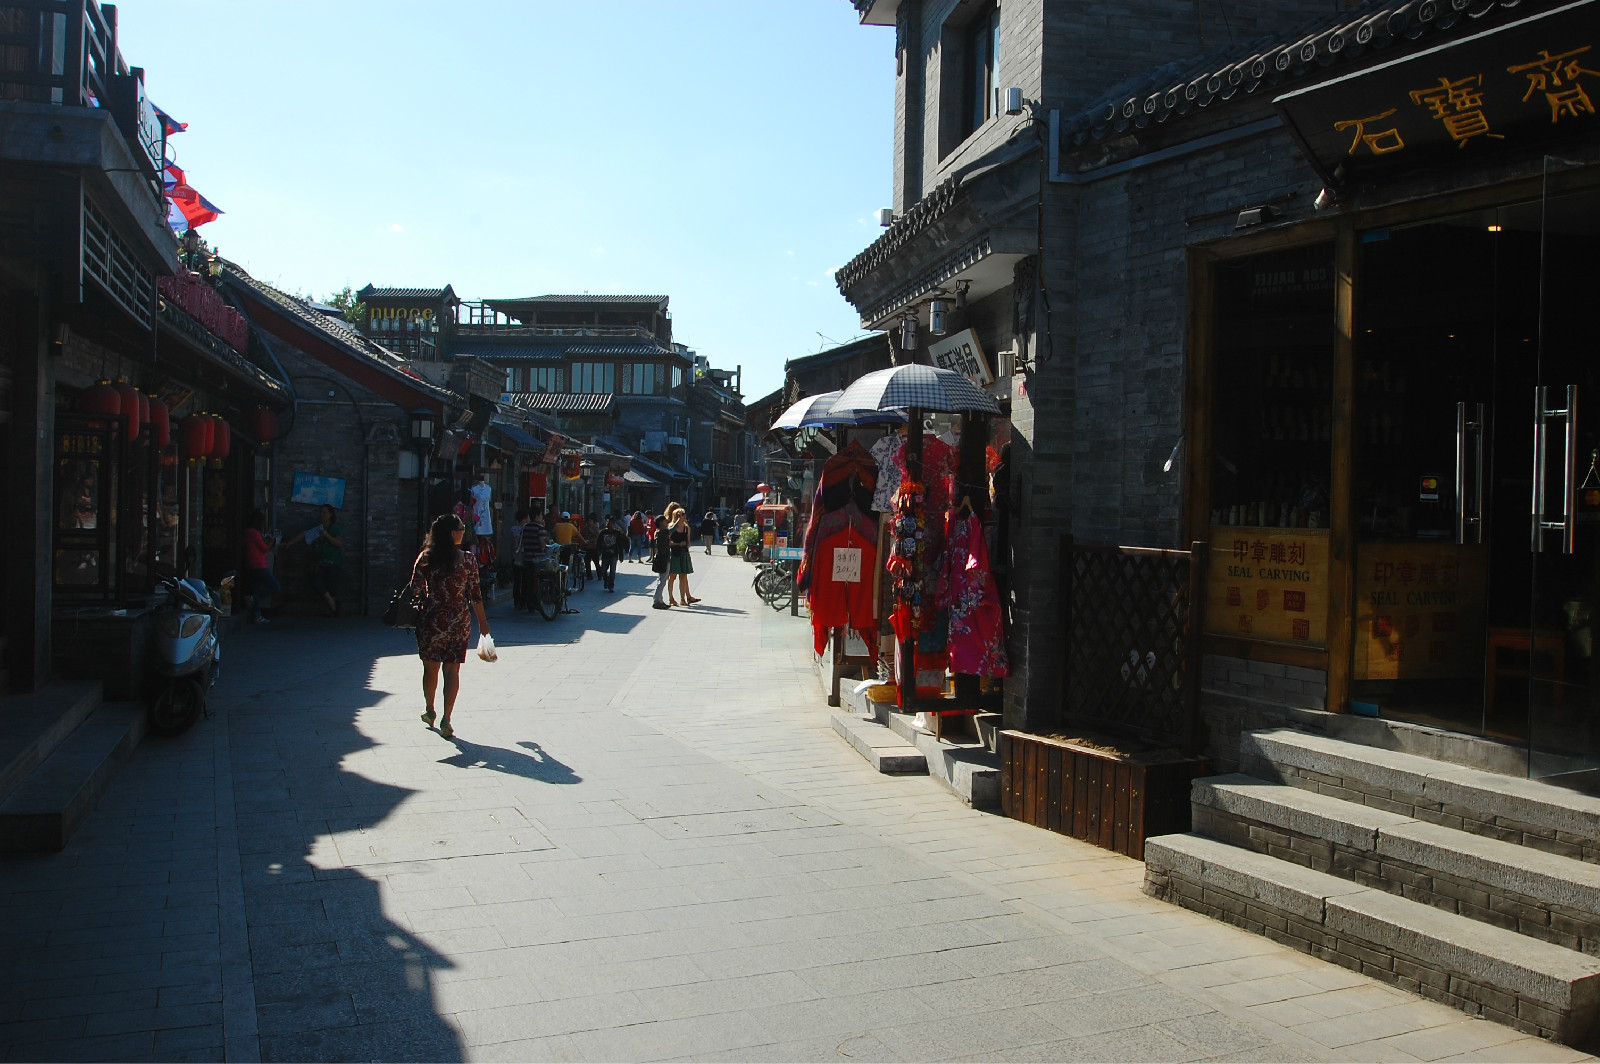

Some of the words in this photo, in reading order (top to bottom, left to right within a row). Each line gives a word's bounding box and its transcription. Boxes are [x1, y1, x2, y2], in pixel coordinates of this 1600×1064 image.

[1233, 539, 1306, 566] 印章雕刻
[1228, 565, 1253, 579] SEAL
[1259, 568, 1310, 582] CARVING
[1374, 559, 1460, 587] 印章雕刻
[1370, 590, 1400, 606] SEAL
[1406, 591, 1463, 606] CARVING
